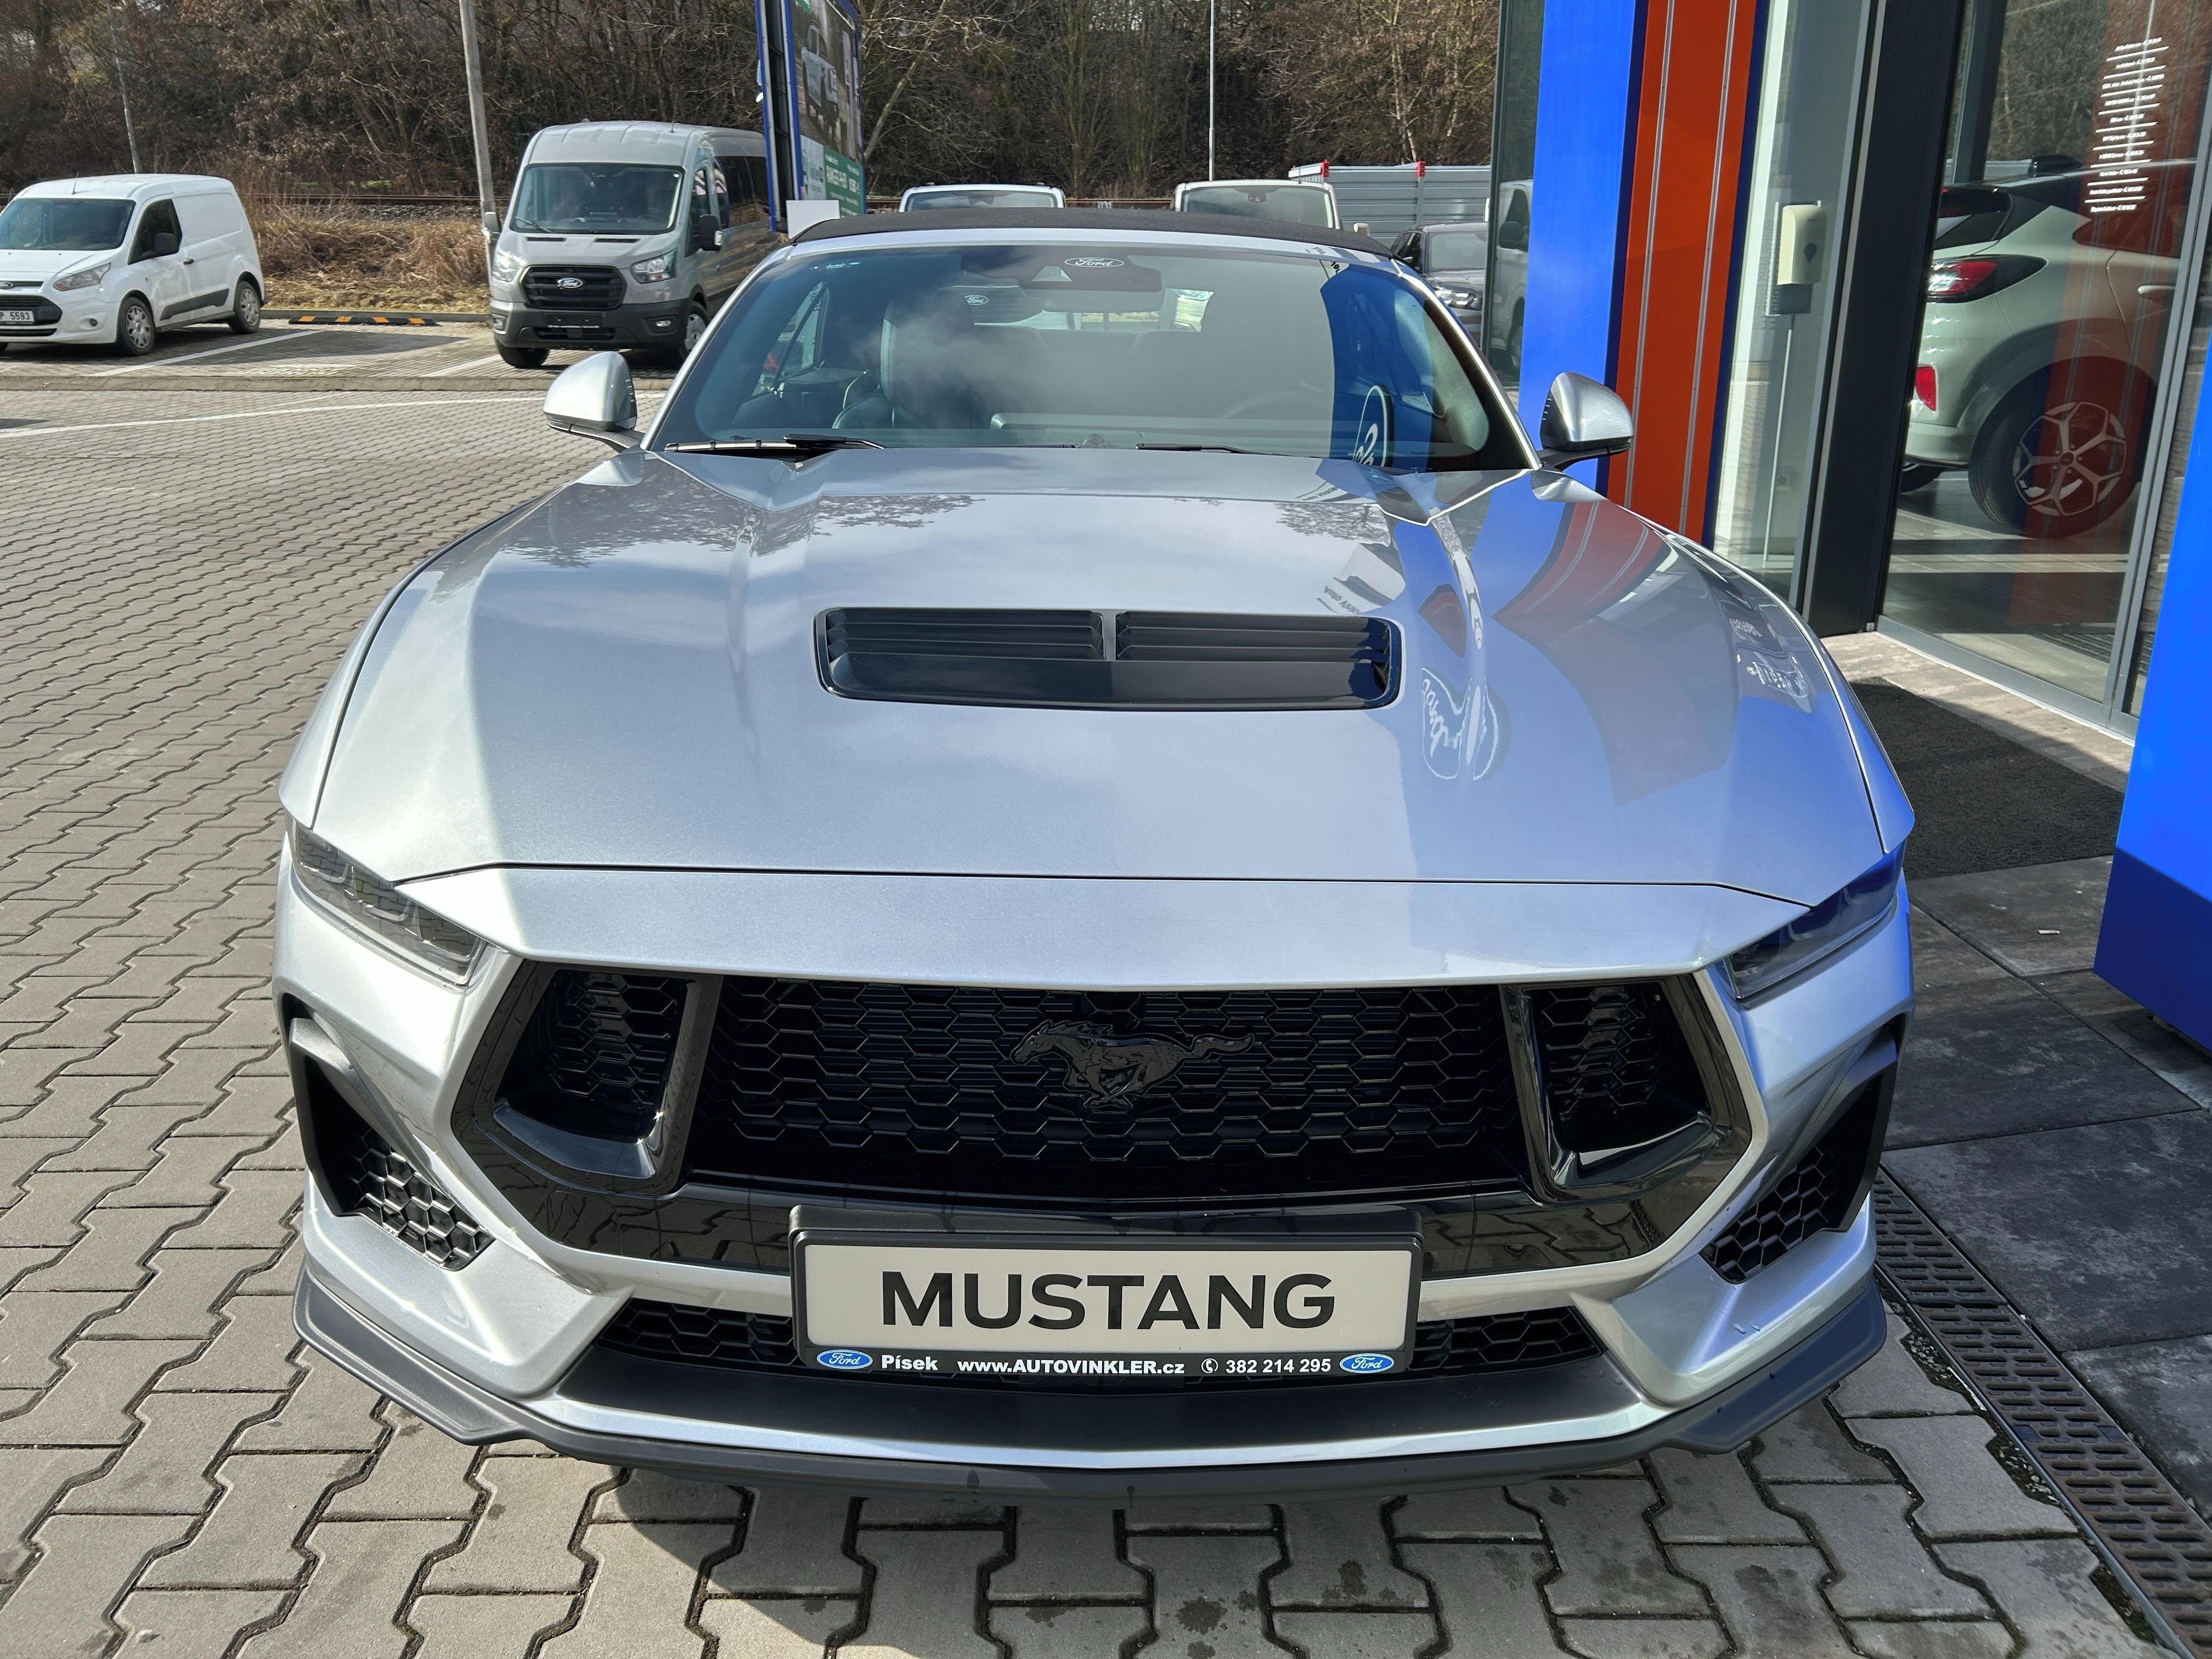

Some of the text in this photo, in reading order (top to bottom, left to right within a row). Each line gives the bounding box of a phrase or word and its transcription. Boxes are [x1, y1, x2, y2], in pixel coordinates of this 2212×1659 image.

[1075, 258, 1113, 267] Ford
[10, 312, 30, 320] 5593
[882, 1271, 1335, 1330] MUSTANG
[828, 1352, 1384, 1374] Ford Písek www.AUTOVINKLER.cz 382 214 295 Ford
